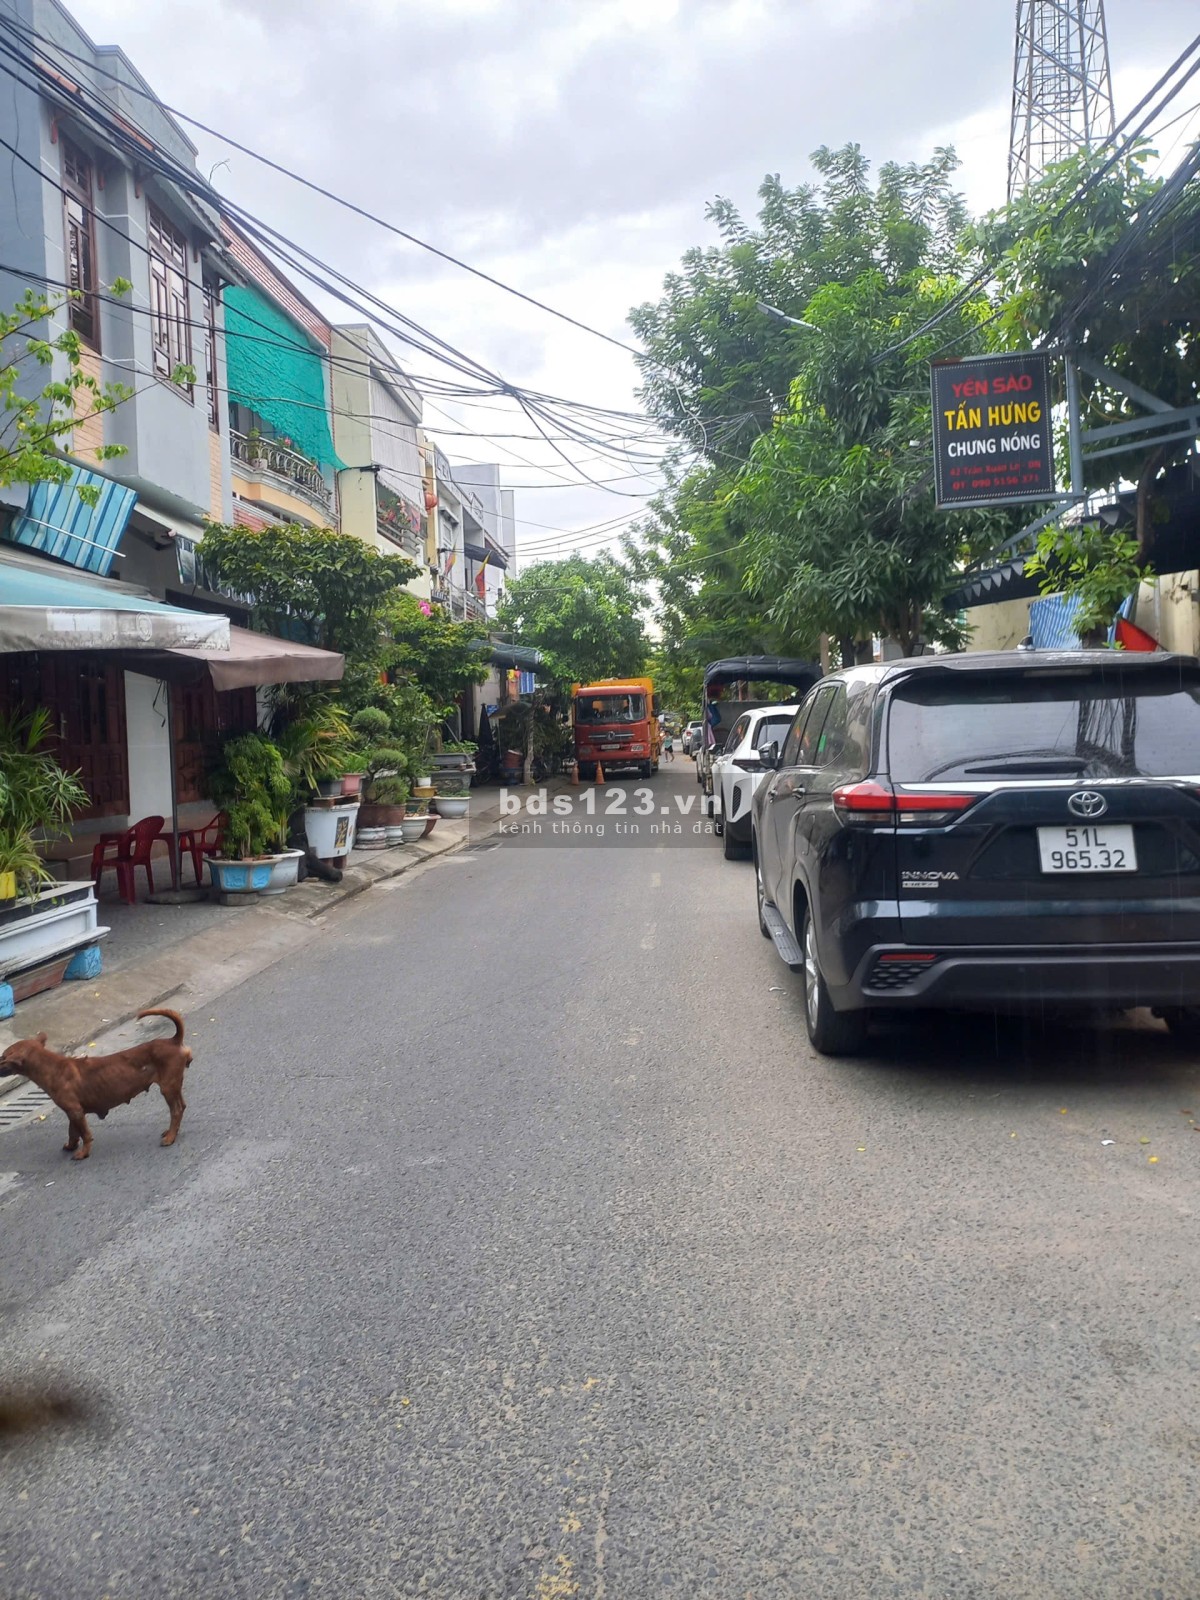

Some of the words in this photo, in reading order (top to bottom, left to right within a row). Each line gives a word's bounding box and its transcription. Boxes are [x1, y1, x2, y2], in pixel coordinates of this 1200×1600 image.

[944, 400, 982, 431] TẤN
[988, 401, 1041, 427] HƯNG
[948, 438, 996, 458] CHƯNG
[1001, 431, 1041, 453] NÓNG
[1065, 828, 1107, 847] 51L
[1051, 849, 1126, 870] 965.32
